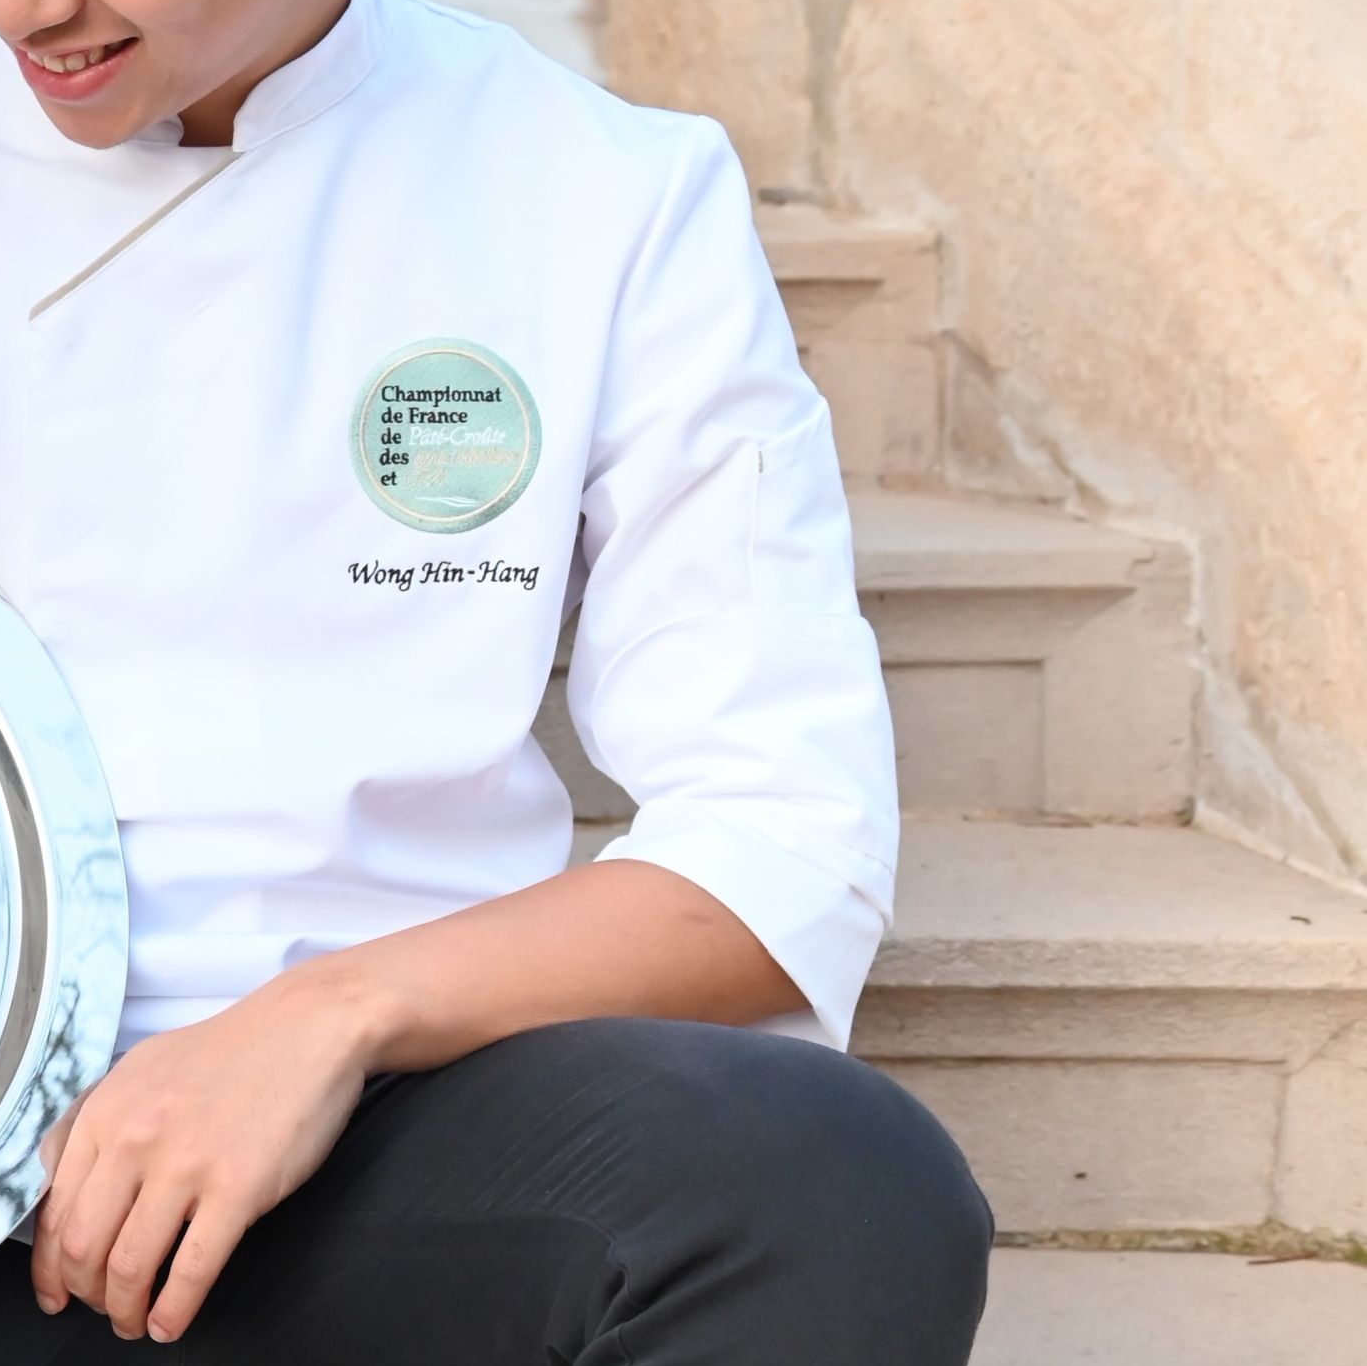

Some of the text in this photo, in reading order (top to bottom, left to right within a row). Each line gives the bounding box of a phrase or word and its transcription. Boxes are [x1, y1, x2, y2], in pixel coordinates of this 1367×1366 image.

[381, 385, 502, 407] Championnat
[381, 407, 468, 424] de France
[381, 428, 402, 445] de
[379, 448, 409, 465] des
[380, 470, 397, 486] et
[348, 559, 540, 592] Wong Hin-Hang
